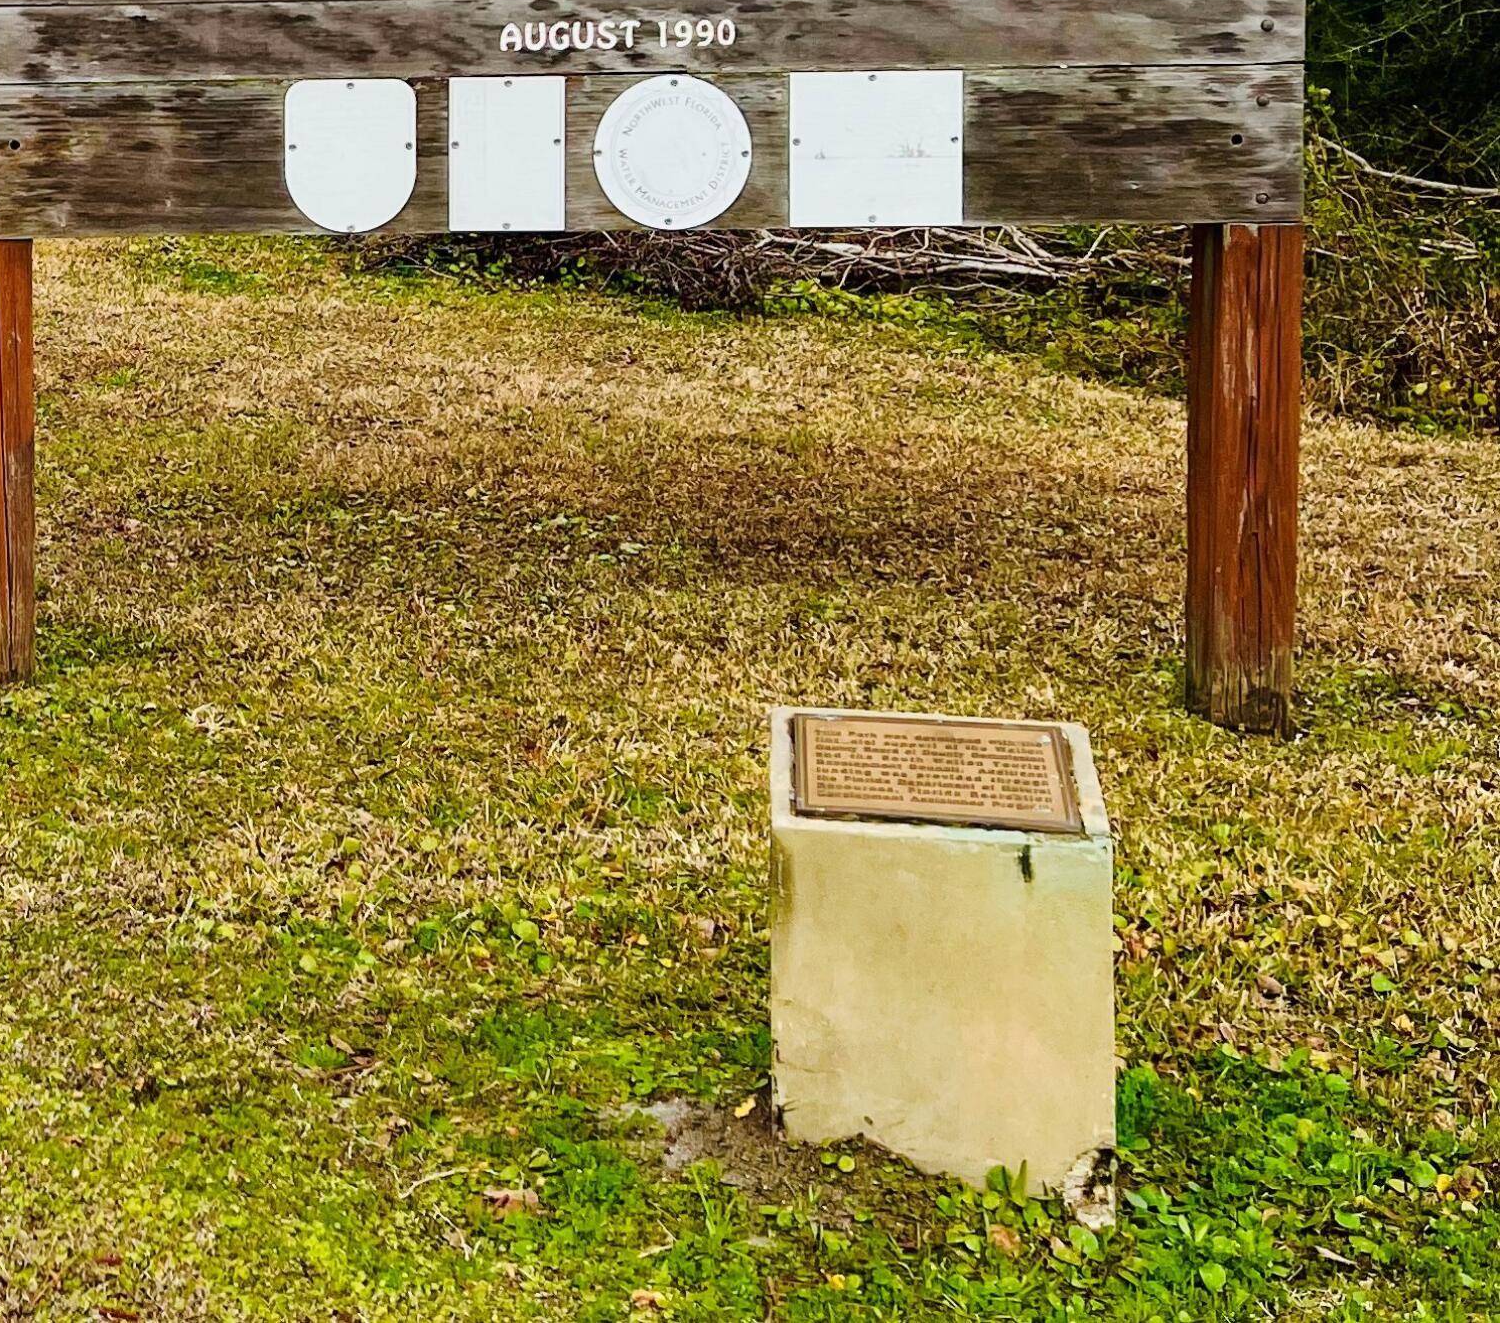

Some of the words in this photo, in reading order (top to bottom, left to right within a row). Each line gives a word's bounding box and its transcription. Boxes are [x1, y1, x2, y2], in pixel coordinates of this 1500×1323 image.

[499, 19, 641, 52] AUGUST
[657, 18, 736, 48] 1990
[684, 96, 722, 131] FLORIDA
[635, 185, 709, 209] MANAGEMENT
